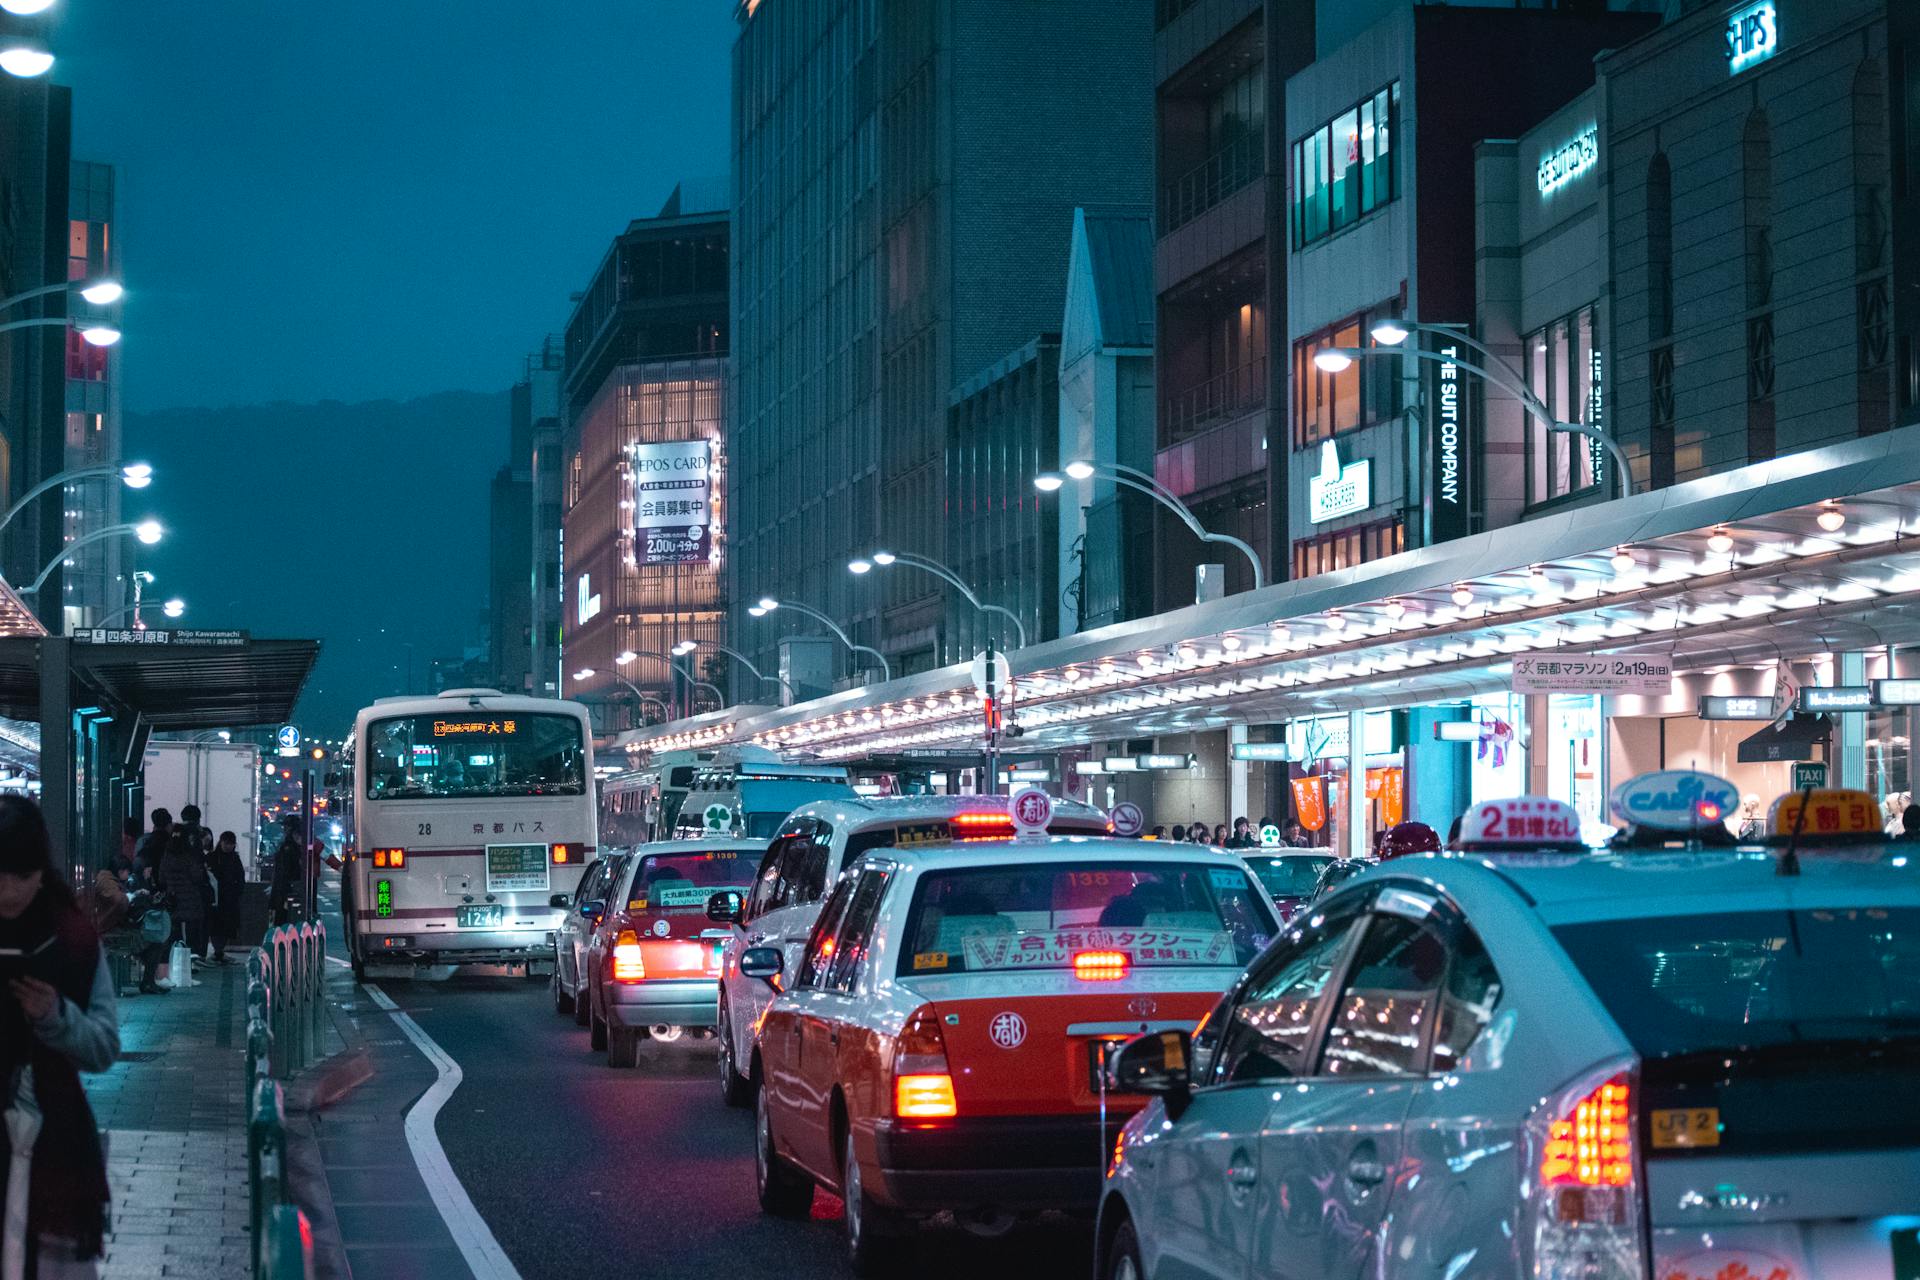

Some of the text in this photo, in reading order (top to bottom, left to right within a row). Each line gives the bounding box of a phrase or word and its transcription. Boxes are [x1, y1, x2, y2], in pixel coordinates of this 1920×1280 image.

[1725, 10, 1766, 60] SHIPS
[1441, 347, 1458, 504] THE SUIT COMPANY
[639, 457, 707, 472] EPOS CARD
[642, 500, 703, 516] 会員募集中
[107, 631, 169, 643] 四条河原町
[177, 630, 193, 638] Shijo
[1536, 662, 1607, 675] 京都マラソン
[1615, 661, 1669, 676] 2月19日(日)
[1798, 770, 1823, 780] TAXI
[1023, 797, 1046, 821] 都
[418, 823, 432, 835] 28
[473, 821, 544, 834] 京都バス
[378, 880, 391, 917] 乗降中
[1010, 953, 1067, 964] ガンバレ
[994, 1015, 1022, 1046] 都
[1697, 1113, 1710, 1130] 2
